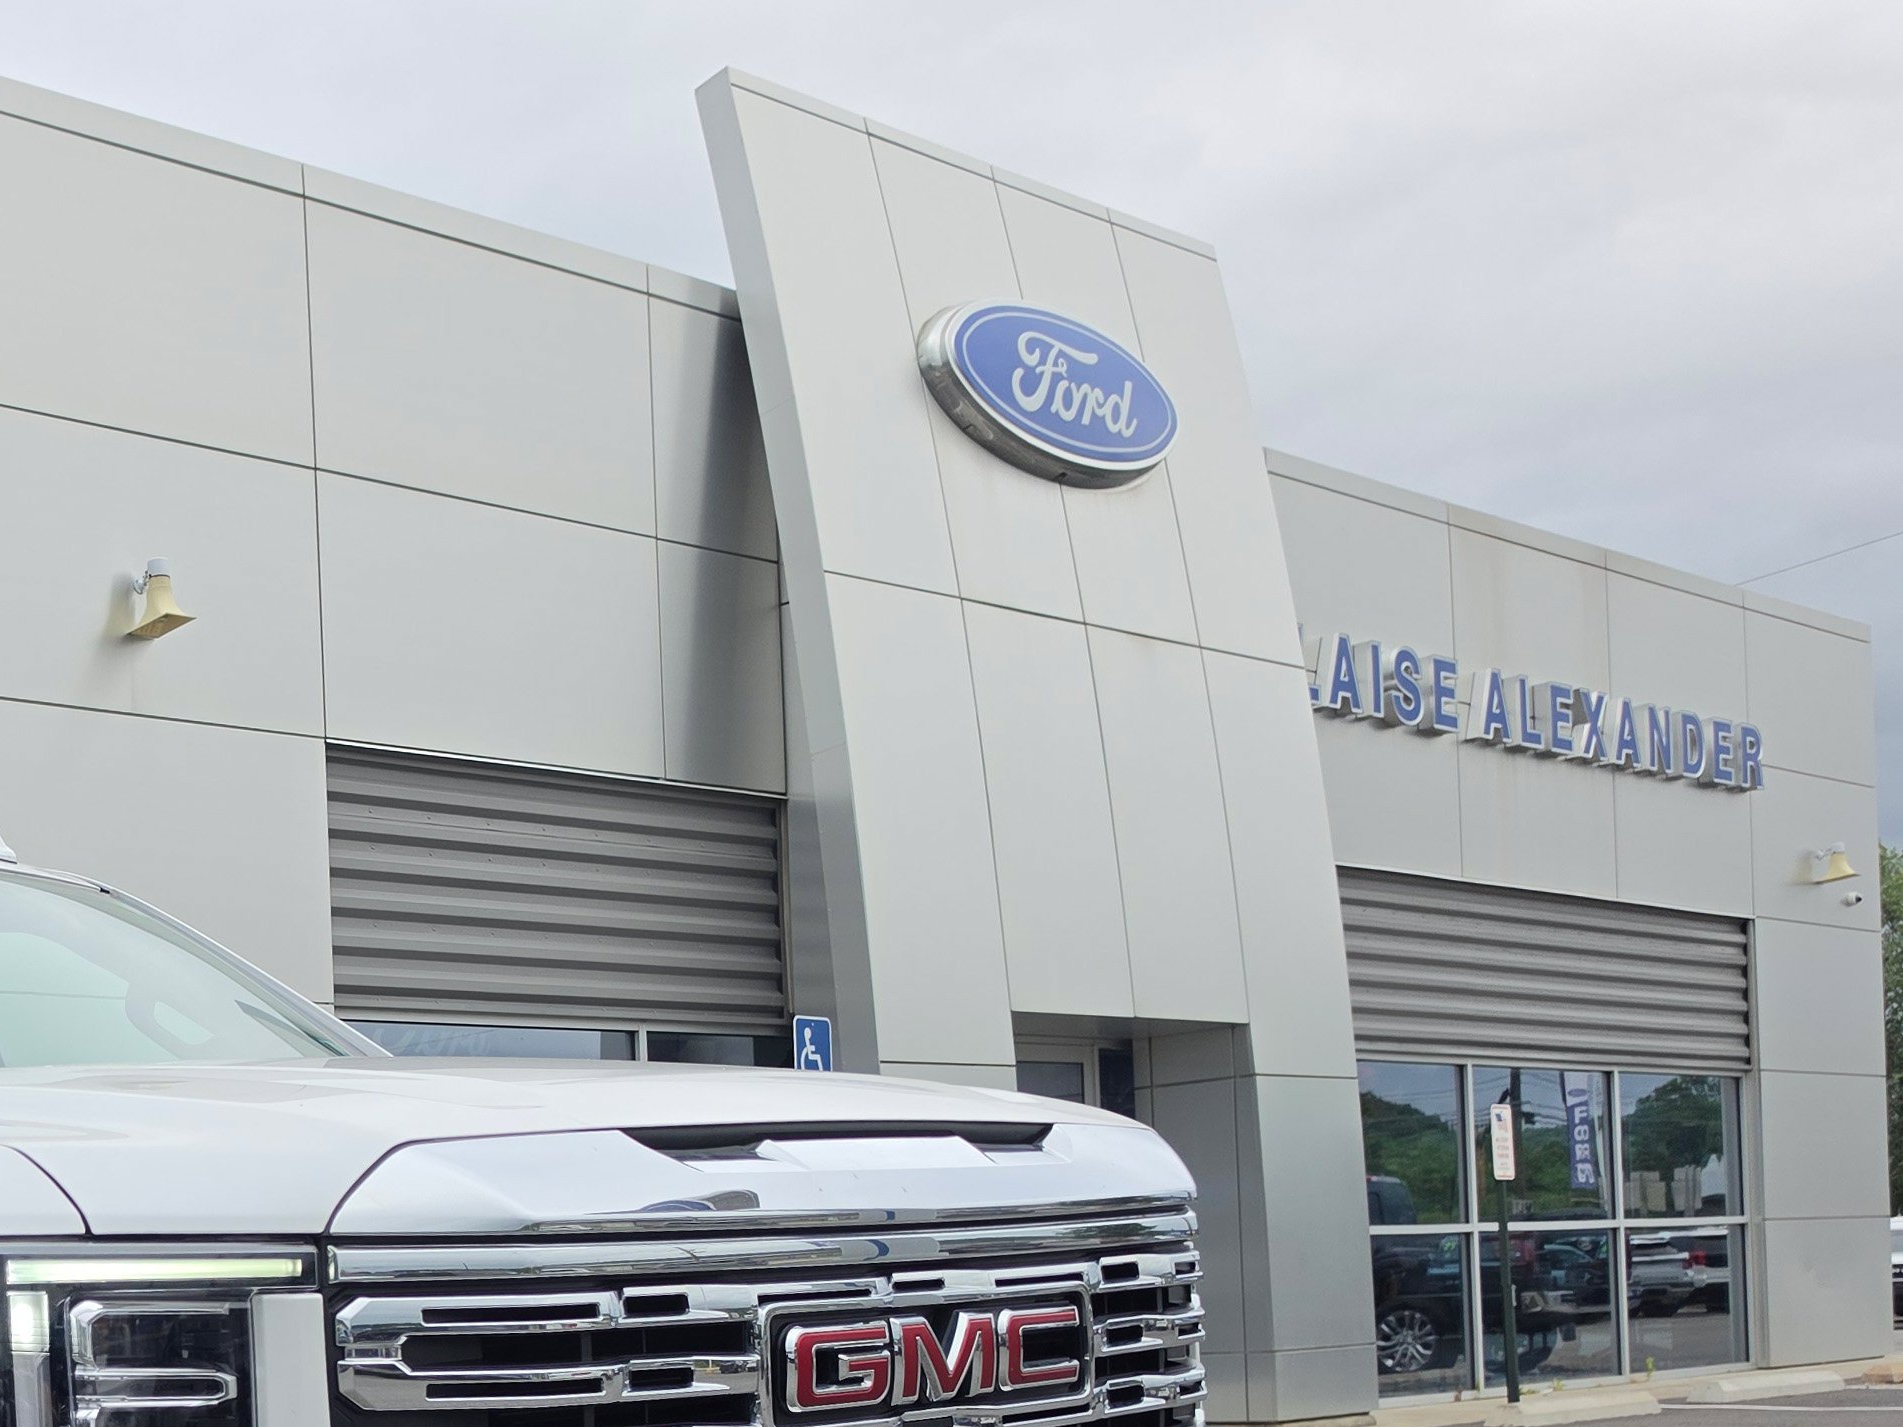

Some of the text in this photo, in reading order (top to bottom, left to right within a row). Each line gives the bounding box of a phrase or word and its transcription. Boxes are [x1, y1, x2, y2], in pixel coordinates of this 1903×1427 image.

[1011, 330, 1138, 438] Ford
[1476, 668, 1765, 789] ALEXANDER
[785, 1305, 1080, 1413] GMC
